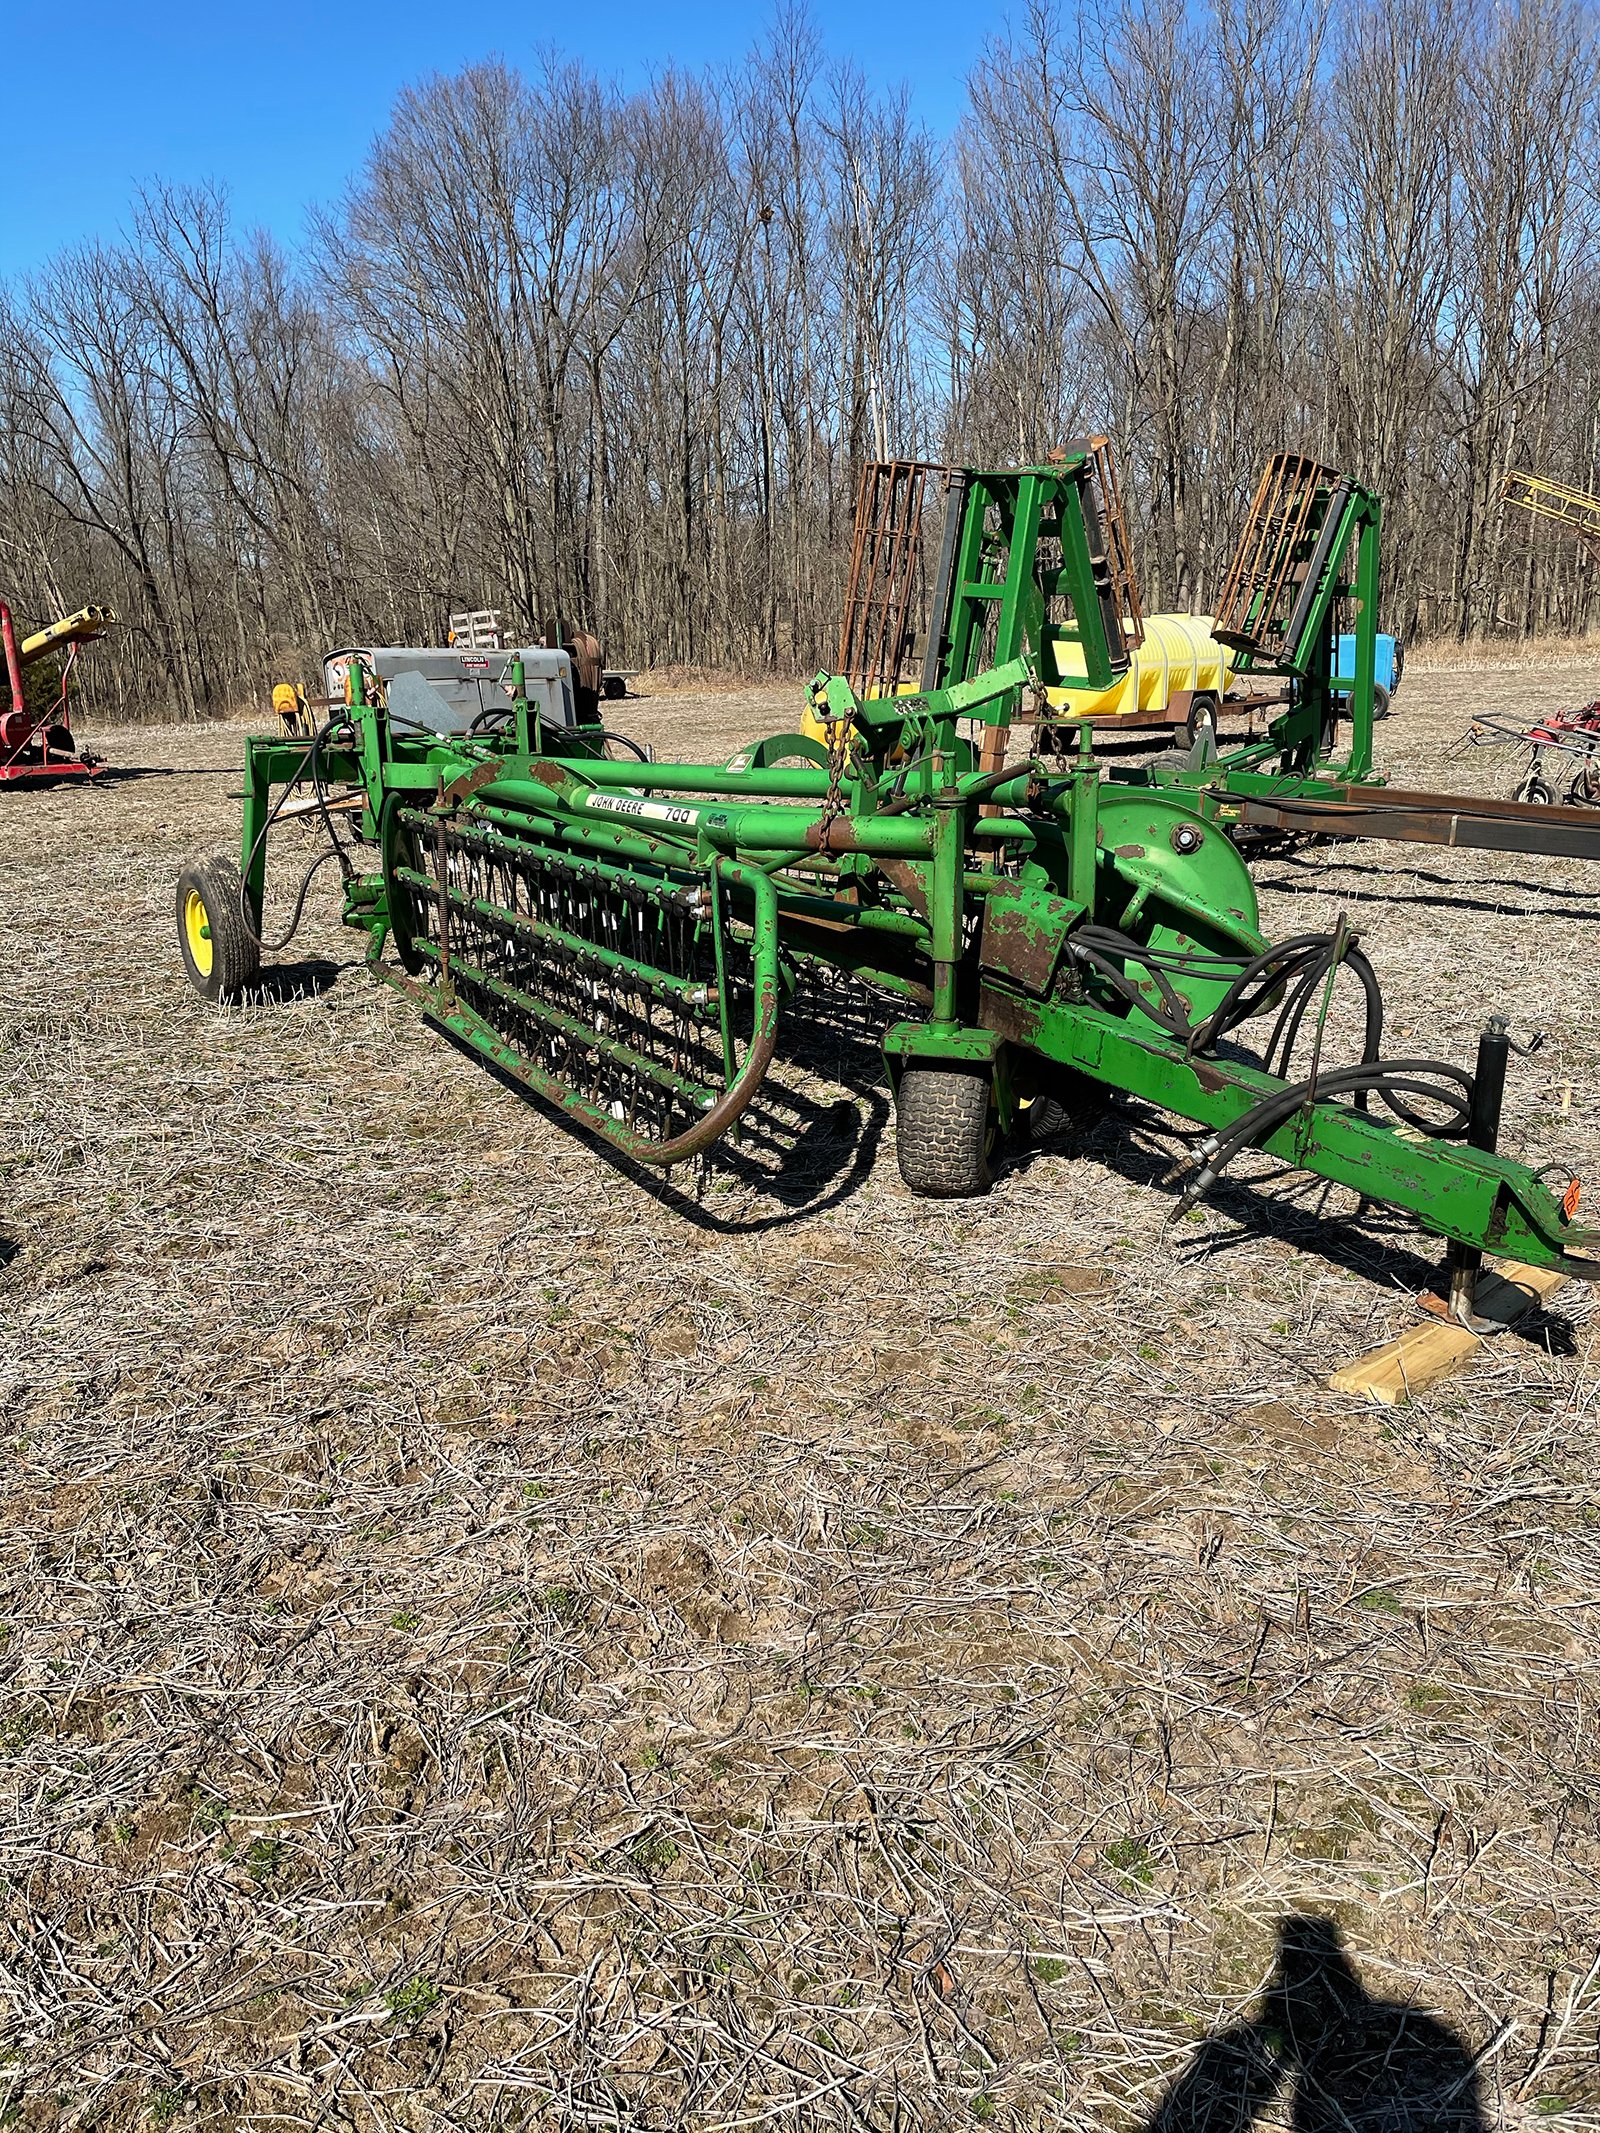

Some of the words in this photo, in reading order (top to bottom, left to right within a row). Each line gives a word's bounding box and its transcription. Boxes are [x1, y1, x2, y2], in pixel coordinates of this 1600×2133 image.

[592, 796, 614, 810] JOHN
[615, 800, 645, 815] DEERE
[664, 807, 691, 823] 700
